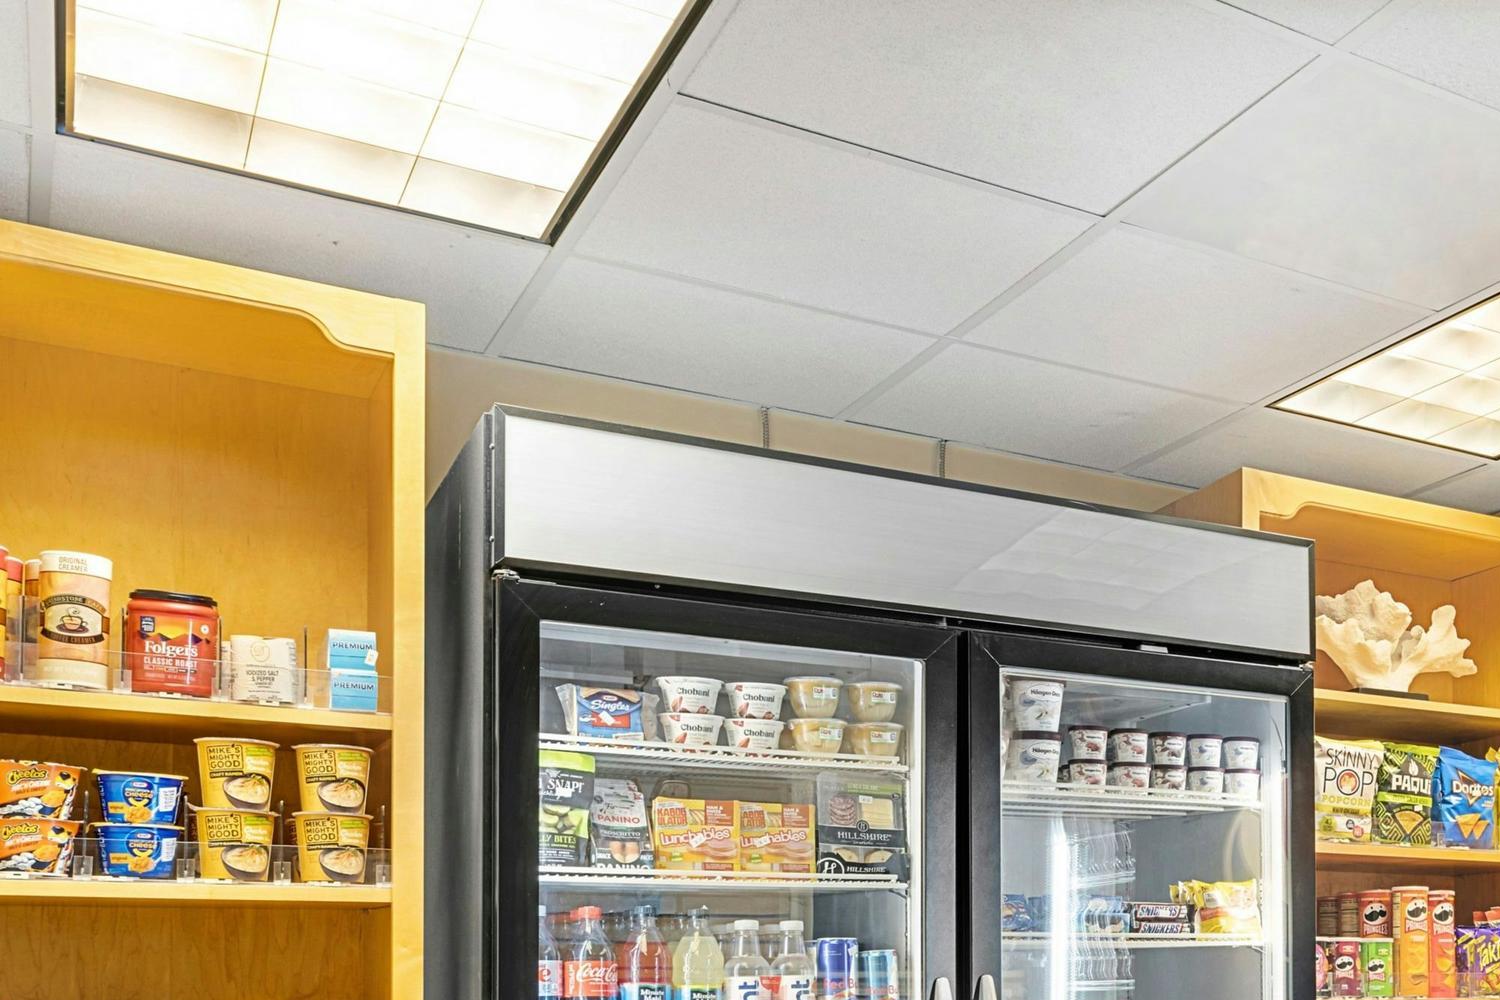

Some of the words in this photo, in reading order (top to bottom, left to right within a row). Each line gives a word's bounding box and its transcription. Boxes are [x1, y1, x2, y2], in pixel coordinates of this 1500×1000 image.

[144, 640, 199, 657] Folgers
[332, 642, 374, 651] PREMIUM
[143, 656, 173, 667] CLASSIC
[175, 658, 199, 669] ROAST
[334, 681, 375, 690] PREMIUM
[677, 686, 711, 698] Chobani
[743, 693, 776, 704] Chobani
[590, 699, 630, 712] Singles
[680, 723, 715, 735] Chobani
[743, 728, 776, 738] Chobani
[208, 745, 240, 755] MIKE'S
[209, 753, 238, 762] MIGHTY
[304, 751, 334, 760] MIKE'S
[1326, 748, 1374, 773] SKINNY
[210, 760, 240, 769] GOOD
[305, 758, 334, 766] MIGHTY
[306, 765, 333, 774] GOOD
[7, 769, 47, 785] Cheetos
[1323, 766, 1374, 799] POP
[1391, 778, 1431, 796] PAQUI
[1452, 780, 1493, 798] Doritos
[1322, 794, 1371, 807] POPCORN
[207, 816, 239, 825] MIKE'S
[305, 819, 336, 828] MIKE'S
[597, 814, 641, 825] PANINO
[1, 824, 39, 841] Cheetos
[208, 823, 237, 832] MIGHTY
[306, 827, 335, 835] MIGHTY
[209, 830, 239, 839] GOOD
[307, 833, 336, 843] GOOD
[553, 833, 577, 844] BITES
[837, 832, 891, 842] HILLSHIRE
[845, 865, 886, 874] HILLSHIRE
[1140, 921, 1181, 935] SNICKERS
[639, 988, 665, 998] Minute
